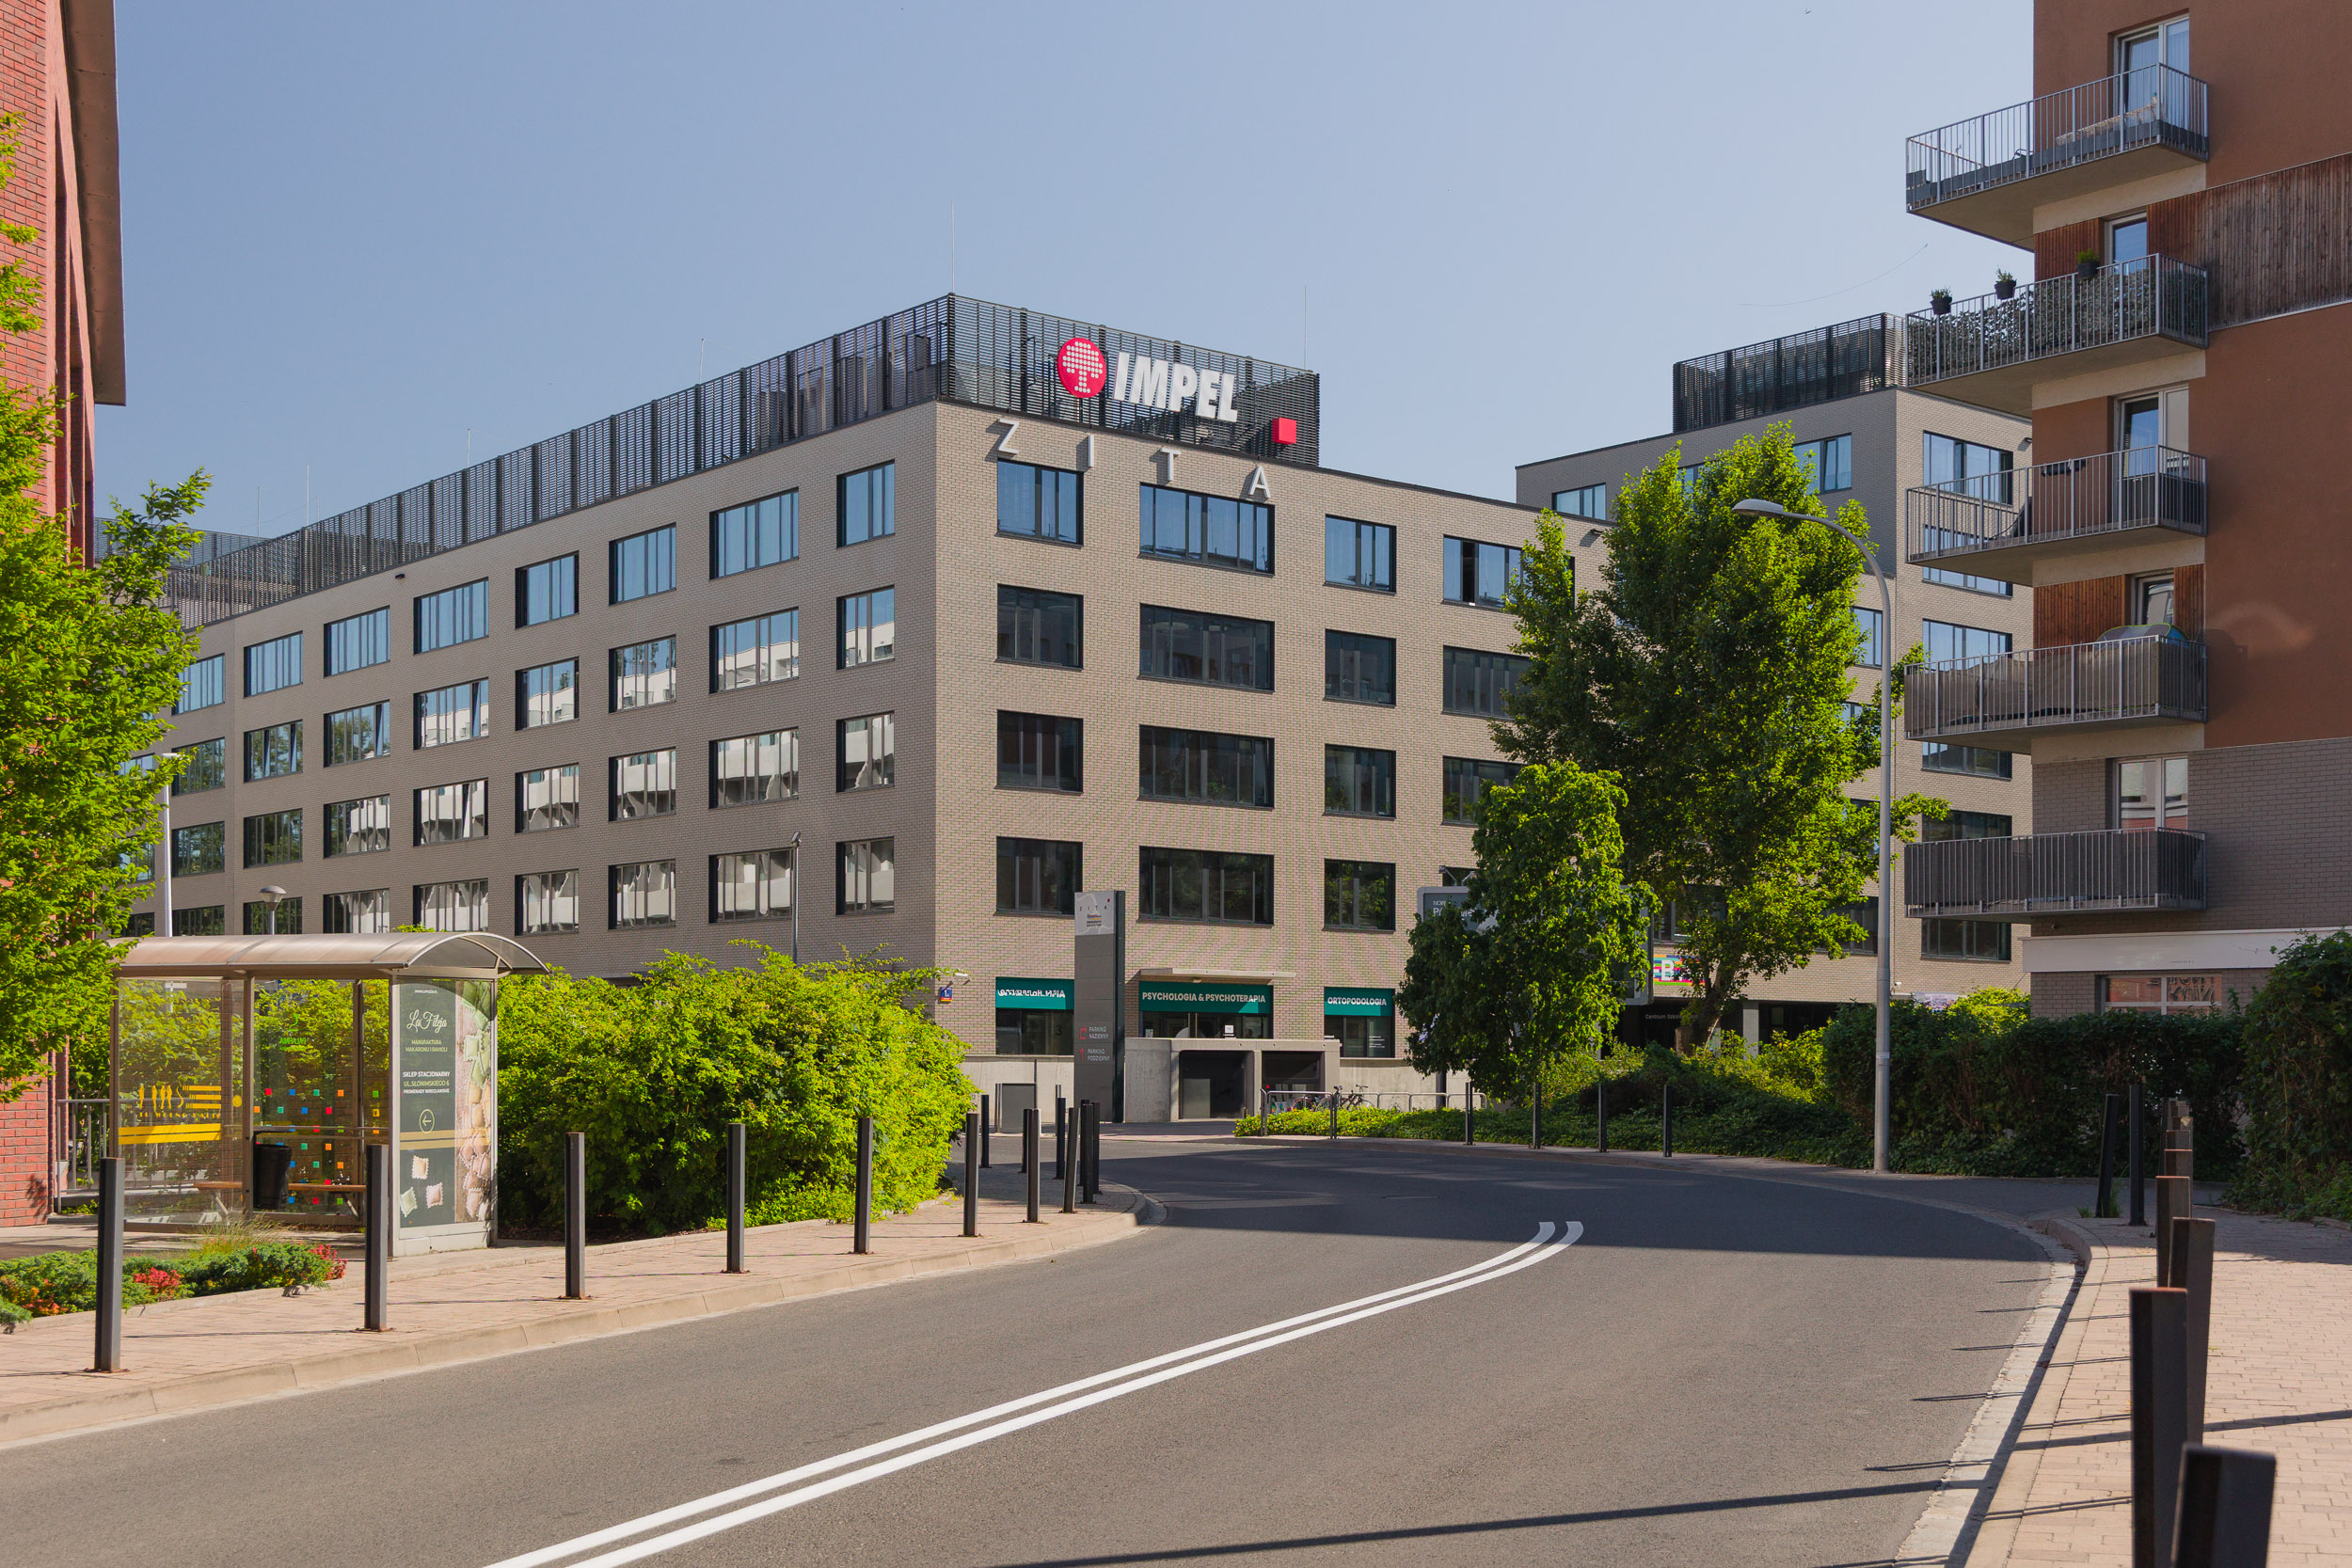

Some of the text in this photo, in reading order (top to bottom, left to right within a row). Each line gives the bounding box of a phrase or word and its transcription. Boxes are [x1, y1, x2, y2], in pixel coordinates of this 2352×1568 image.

[1113, 351, 1238, 422] IMPEL
[1142, 991, 1266, 1003] PSYCHOLOGIA & PSYCHOTERAPIA
[1327, 996, 1387, 1006] ORTOPODOLOGIA
[406, 1008, 421, 1033] La
